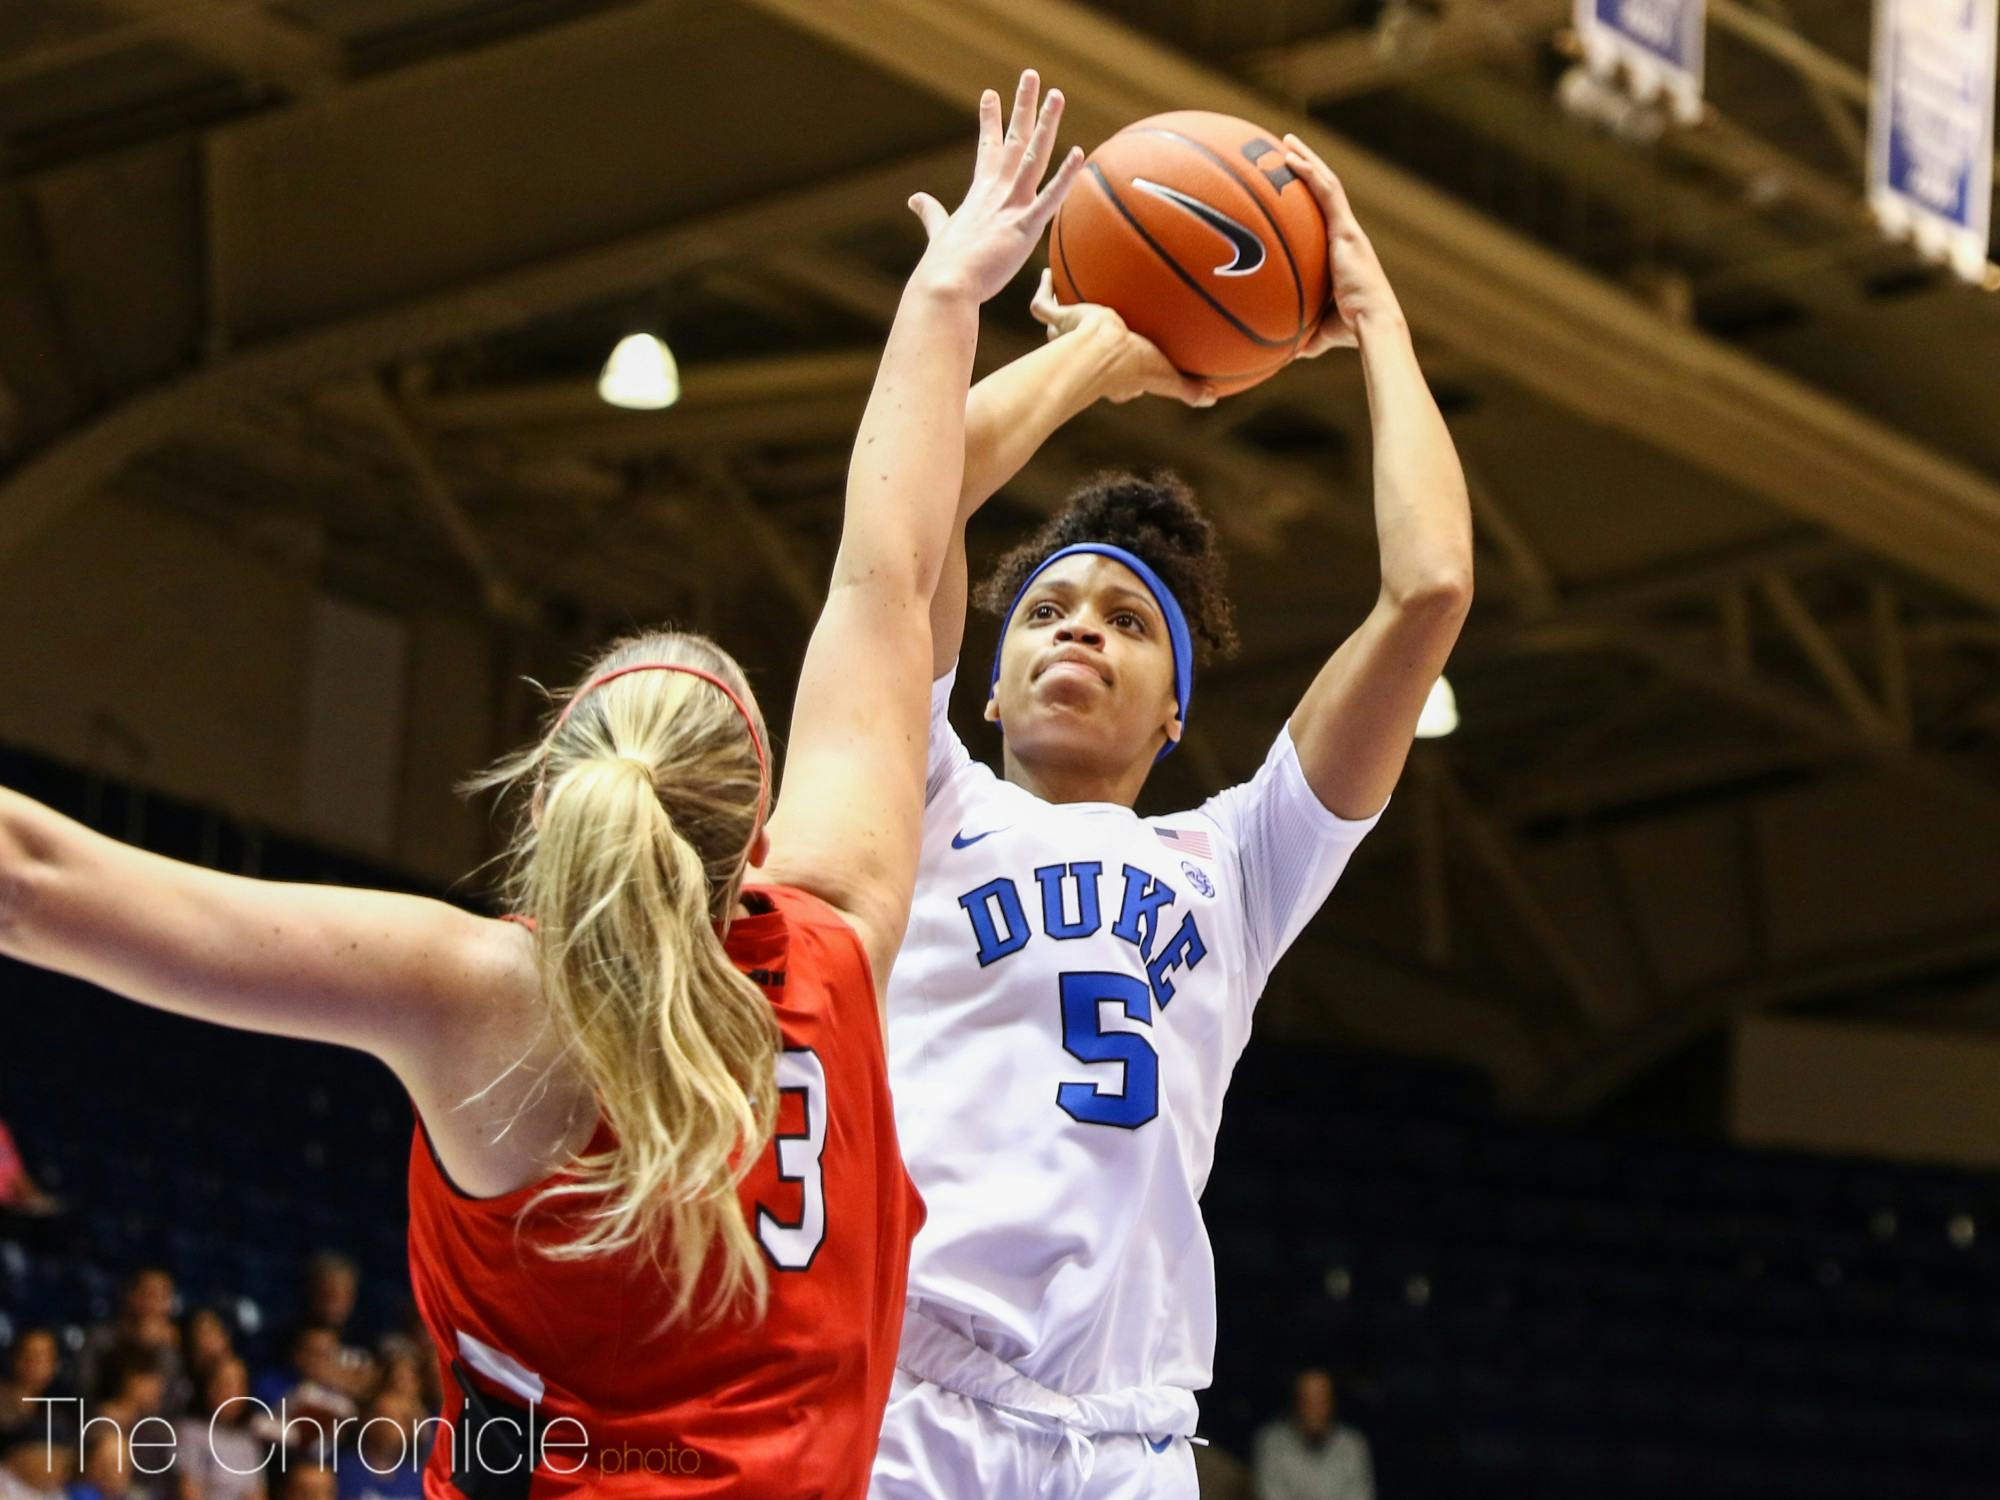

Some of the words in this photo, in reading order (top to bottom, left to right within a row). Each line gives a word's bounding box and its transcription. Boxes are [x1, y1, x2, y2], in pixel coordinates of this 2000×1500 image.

[957, 861, 1208, 1011] DUKE
[1056, 971, 1159, 1130] 5
[755, 1046, 828, 1271] 3
